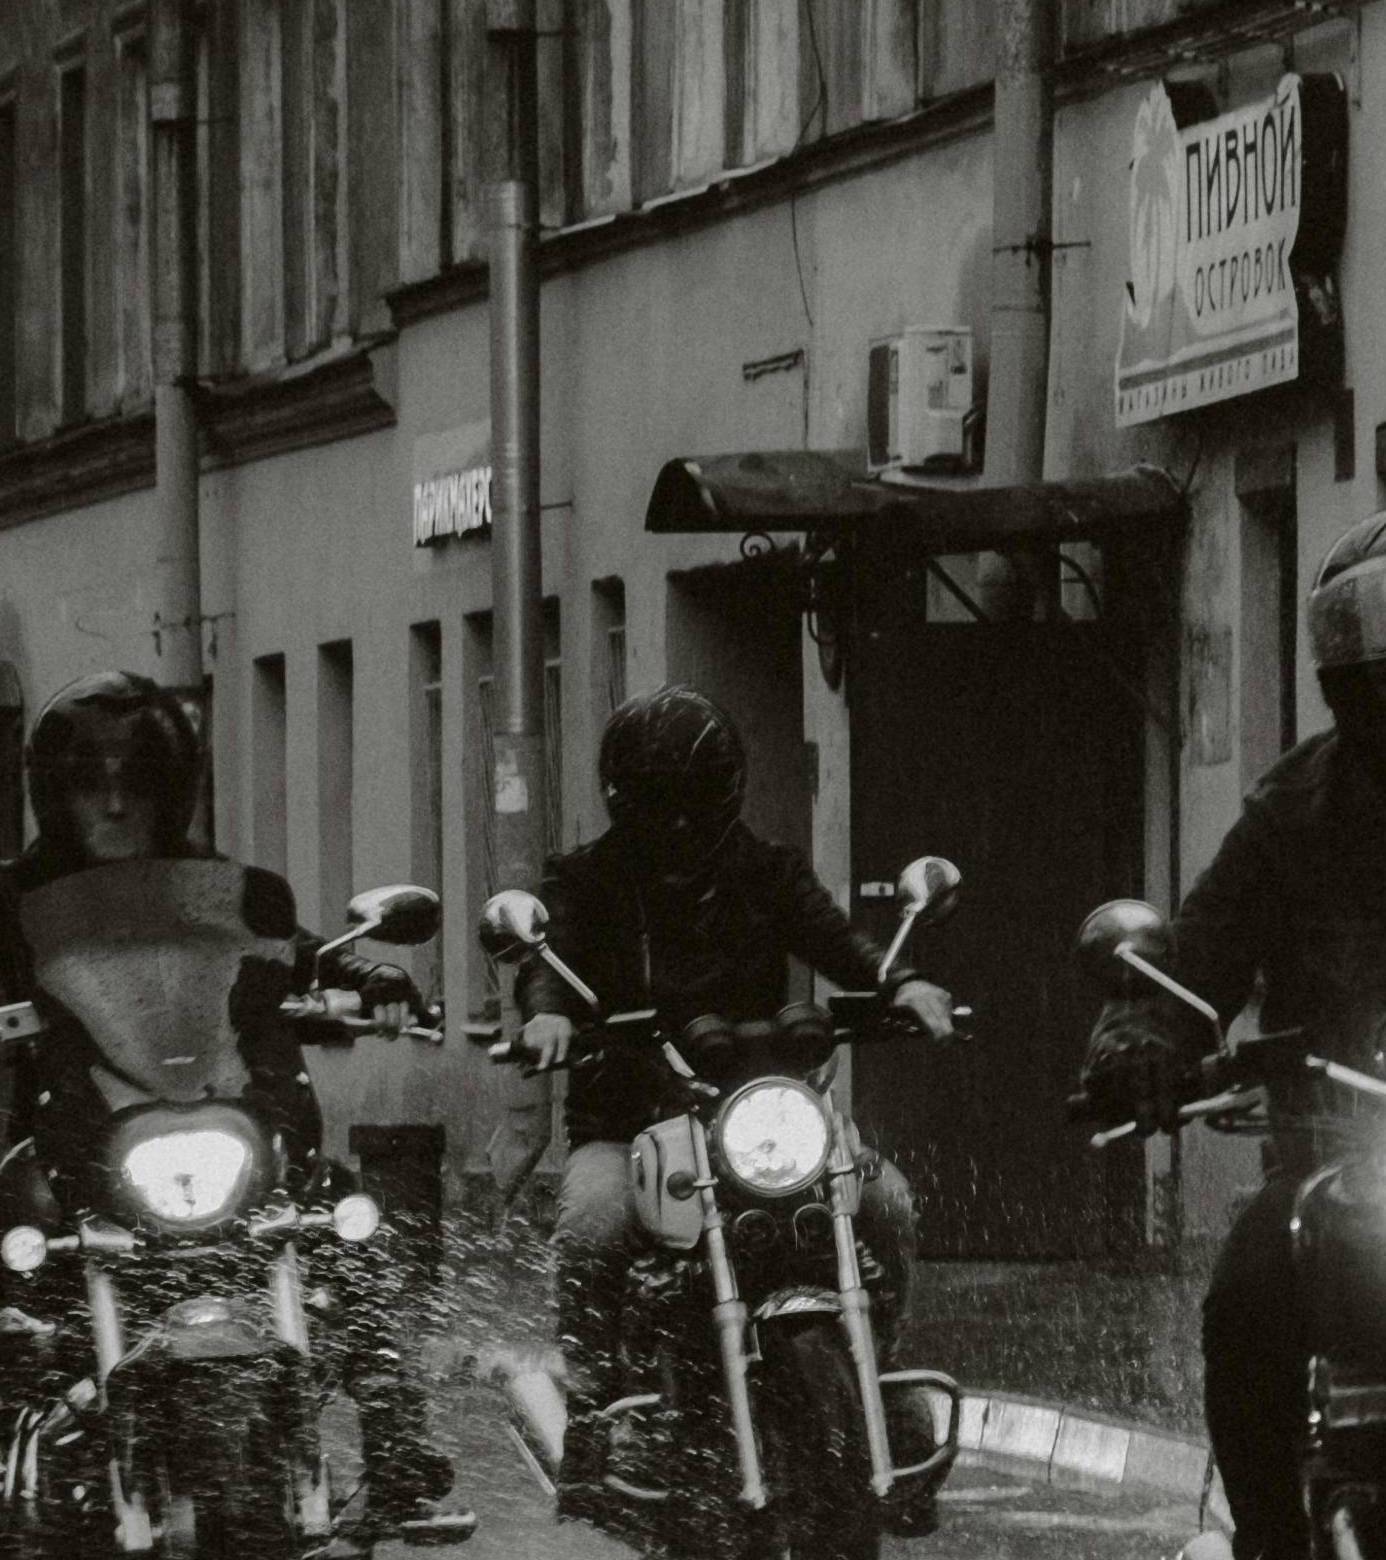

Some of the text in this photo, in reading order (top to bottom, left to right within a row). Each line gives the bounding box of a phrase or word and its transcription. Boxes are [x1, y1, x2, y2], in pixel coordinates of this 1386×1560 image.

[1185, 92, 1296, 243] ПИВНОЙ
[1194, 237, 1287, 318] ОСТРОВОК
[413, 466, 492, 546] ПАРИКМАХЕРС
